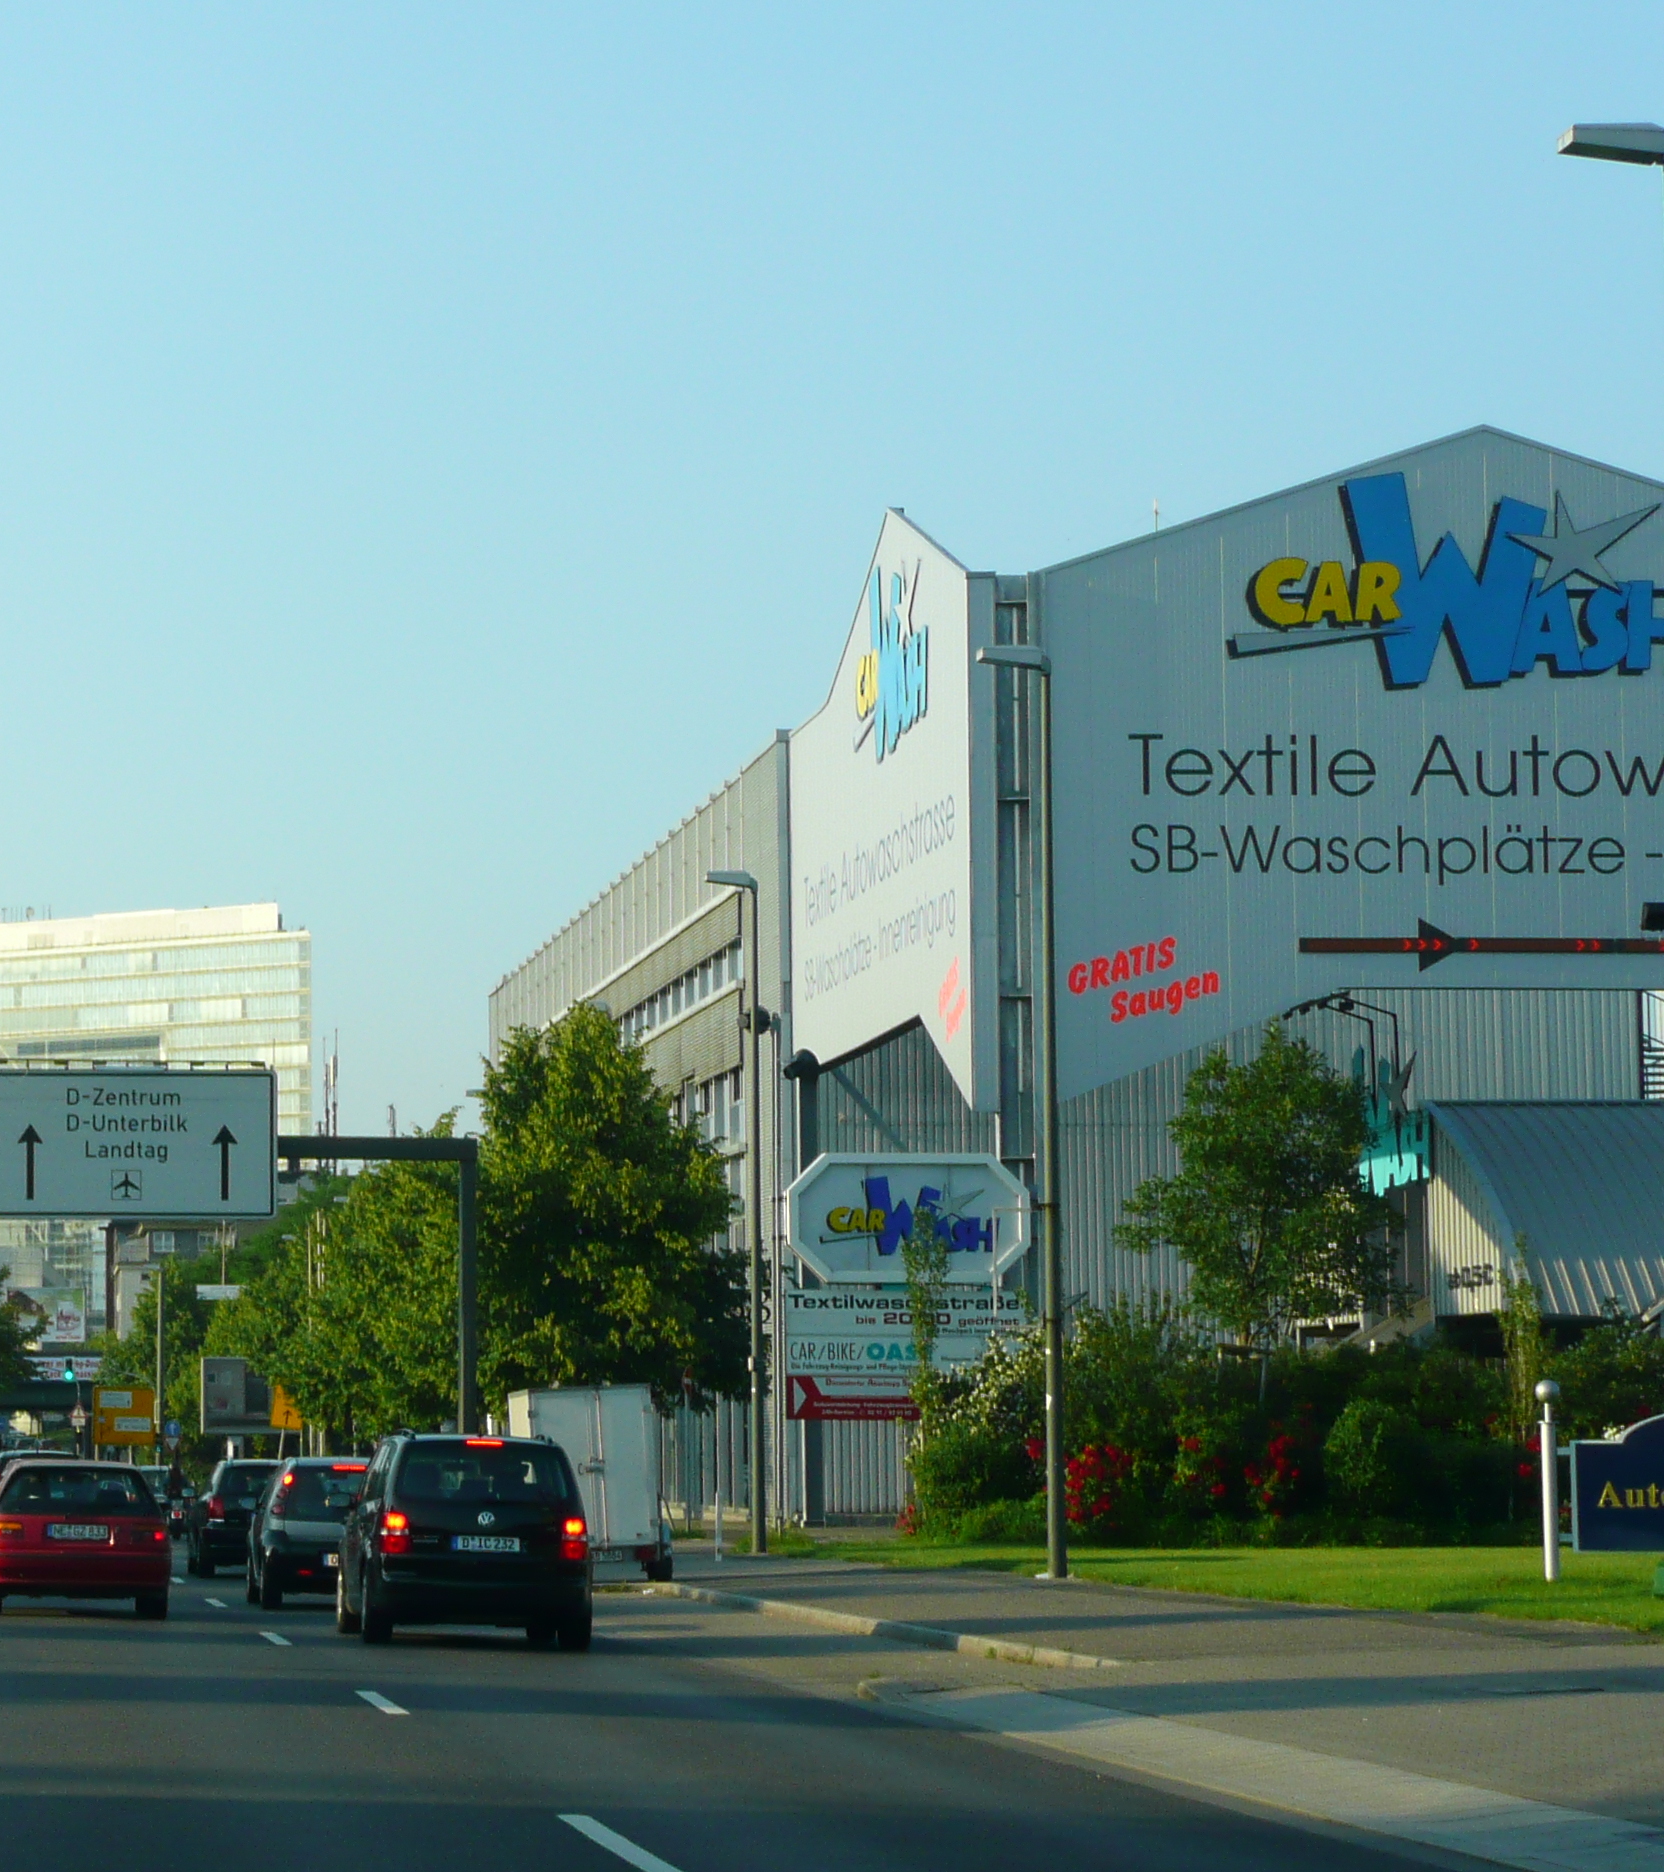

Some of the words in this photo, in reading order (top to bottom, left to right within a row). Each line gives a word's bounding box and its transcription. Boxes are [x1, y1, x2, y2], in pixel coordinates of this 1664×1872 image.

[1248, 556, 1402, 629] CAR
[869, 565, 928, 764] WASH
[1128, 733, 1376, 797] Textile
[1409, 733, 1664, 797] Autow
[803, 862, 837, 928] Textile
[839, 794, 956, 907] Autowaschstrasse
[1130, 824, 1626, 886] SB-Waschplätze
[1067, 935, 1177, 995] GRATIS
[1109, 970, 1221, 1024] Saugen
[66, 1087, 181, 1107] D-Zentrum
[66, 1114, 188, 1133] D-Unterbilk
[85, 1140, 169, 1164] Landtag
[827, 1206, 886, 1234] CAR
[788, 1294, 1020, 1310] Textilwascstraße
[789, 1342, 933, 1362] CAR/BIKE/OAS
[1597, 1480, 1664, 1509] Aut
[461, 1538, 470, 1549] D
[493, 1538, 515, 1550] 232
